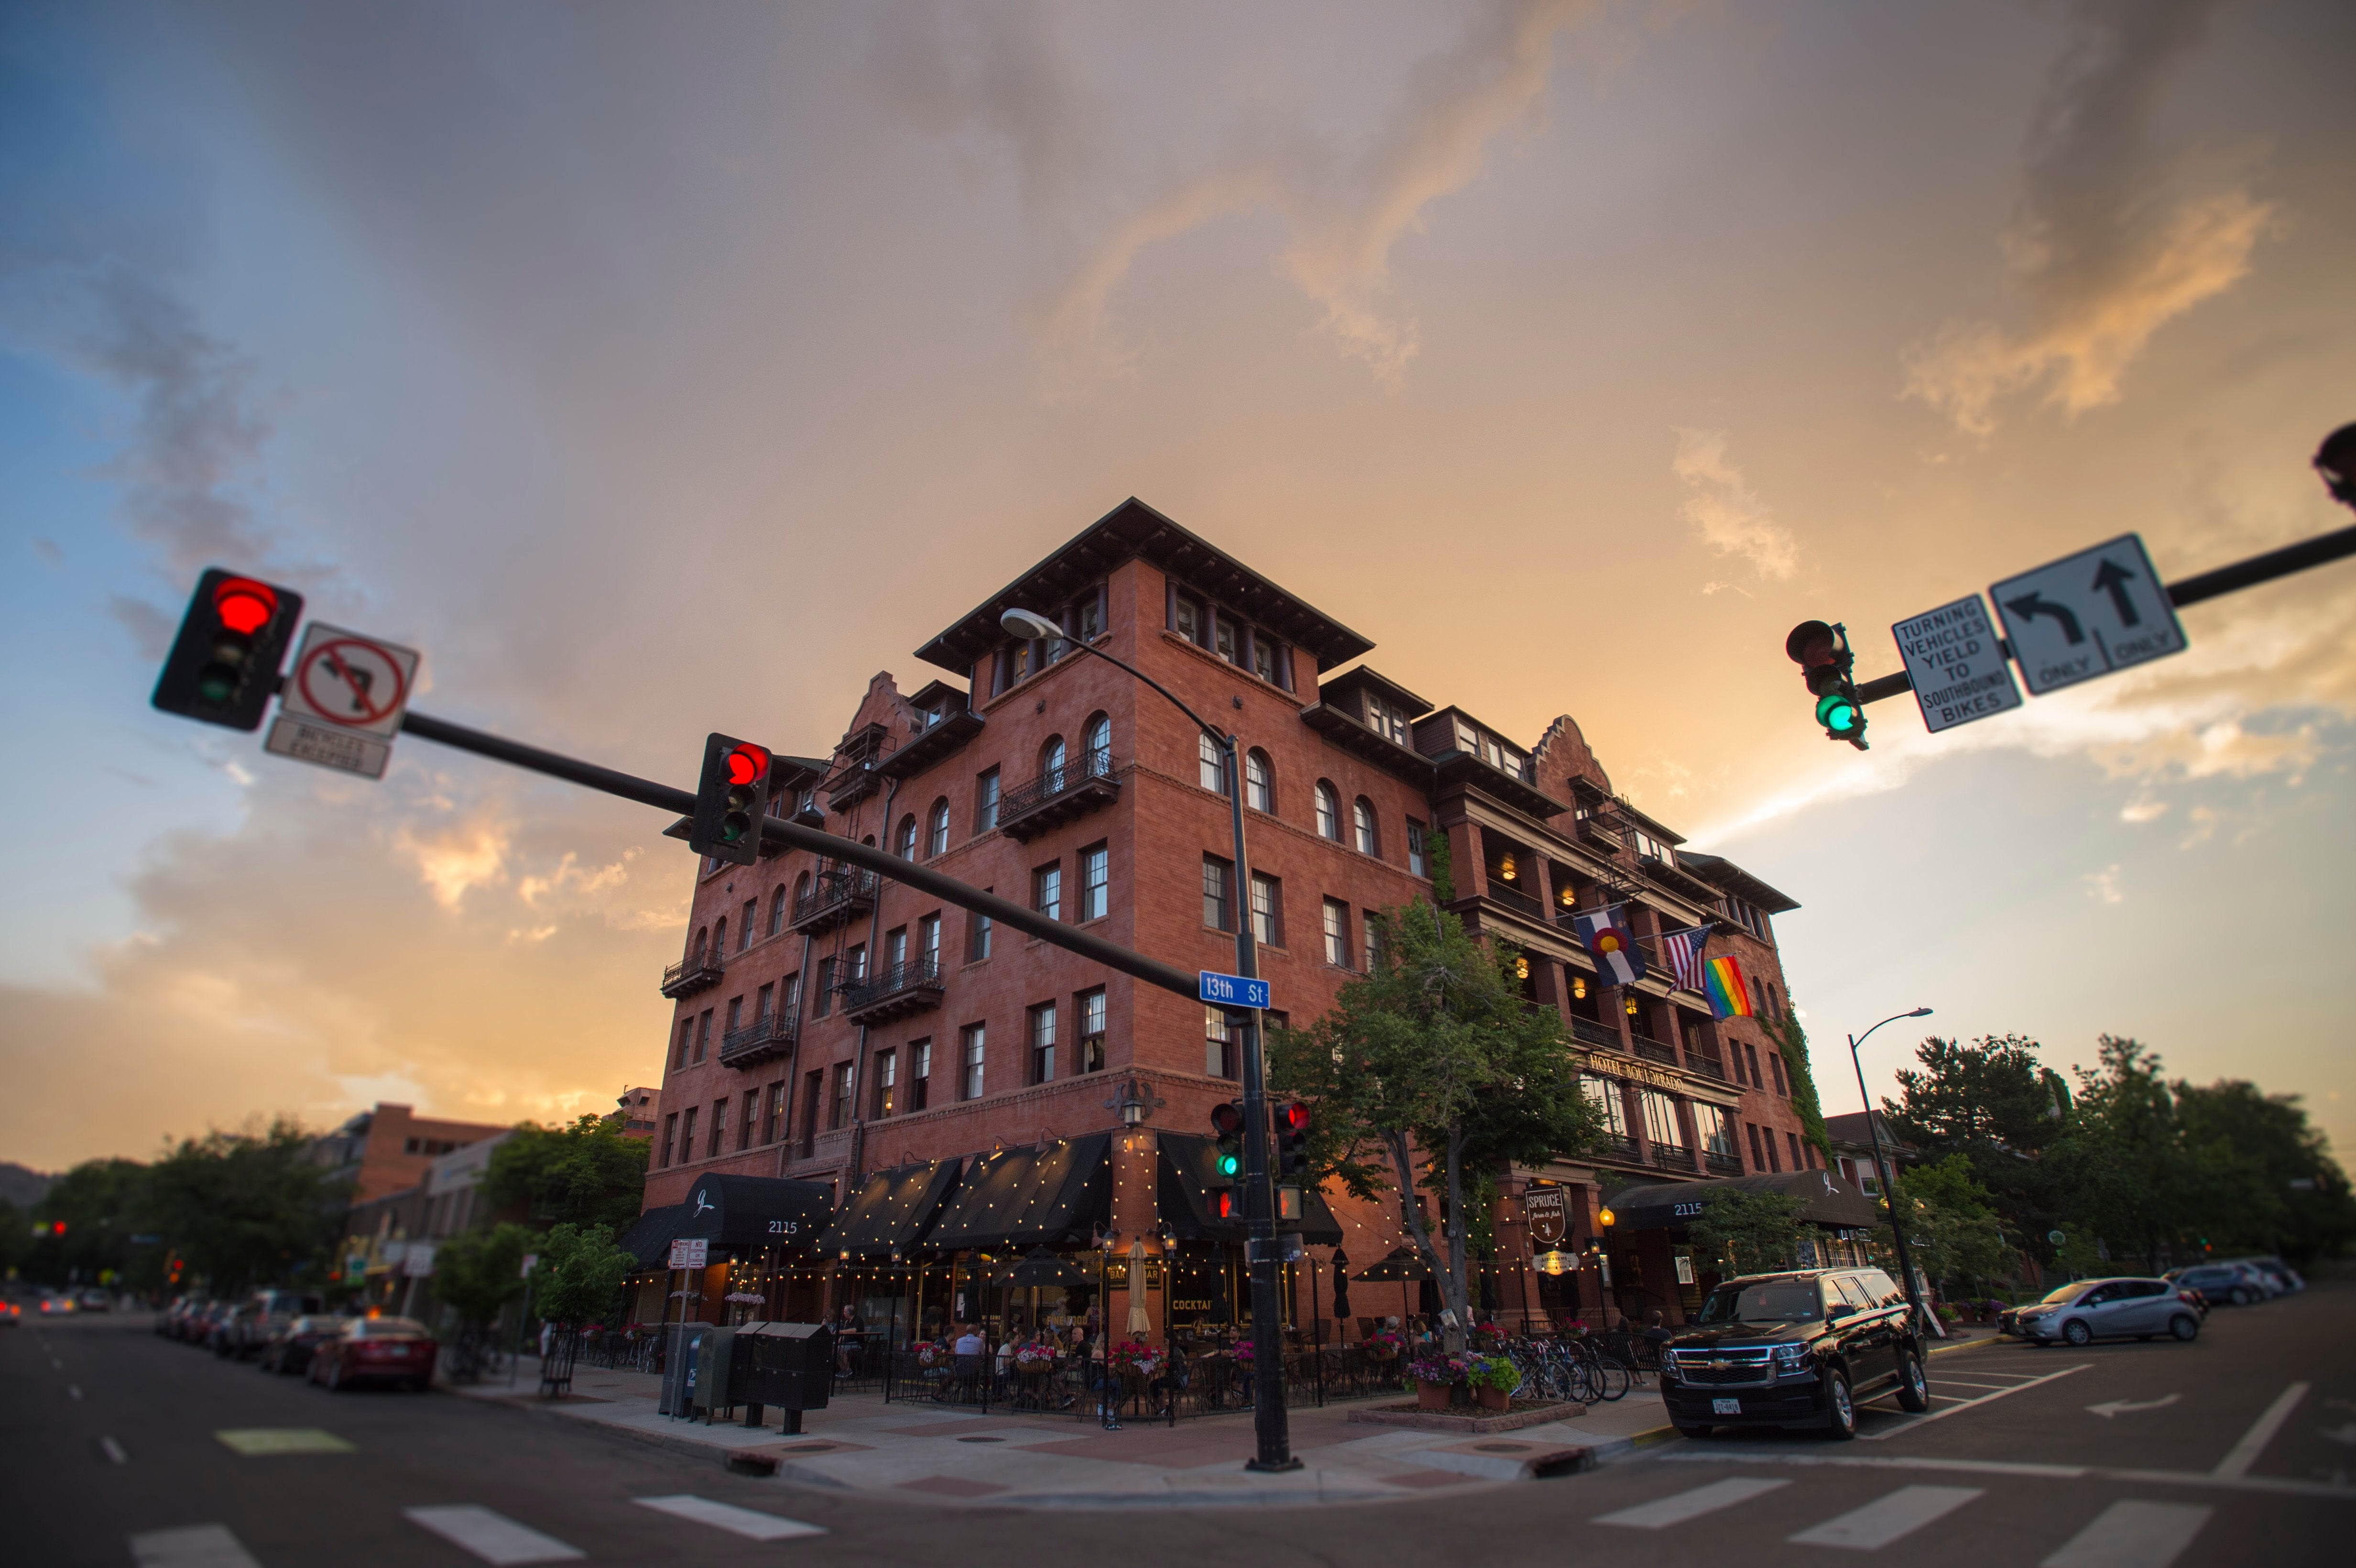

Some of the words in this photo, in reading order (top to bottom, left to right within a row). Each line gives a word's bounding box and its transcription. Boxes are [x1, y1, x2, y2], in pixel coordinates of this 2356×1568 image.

[1900, 601, 1978, 641] TURNING
[1905, 618, 1986, 657] VEHICLES
[2114, 630, 2170, 661] ONLY
[1921, 639, 1981, 669] YIELD
[1943, 662, 1970, 682] TO
[2039, 655, 2090, 684] ONLY
[1923, 670, 2007, 709] SOUTHBOUND
[1941, 692, 2002, 723] BIKES
[1207, 977, 1233, 999] 13th
[1248, 984, 1263, 1003] St
[1589, 1054, 1623, 1077] HOTEL
[1625, 1064, 1684, 1092] BOULDERADO
[1528, 1193, 1560, 1209] SPRUCE
[1674, 1203, 1702, 1215] 2115
[768, 1220, 797, 1234] 2115
[1531, 1212, 1544, 1220] farm
[1549, 1210, 1561, 1219] fish
[1110, 1271, 1125, 1279] BAR
[1147, 1270, 1158, 1279] AR
